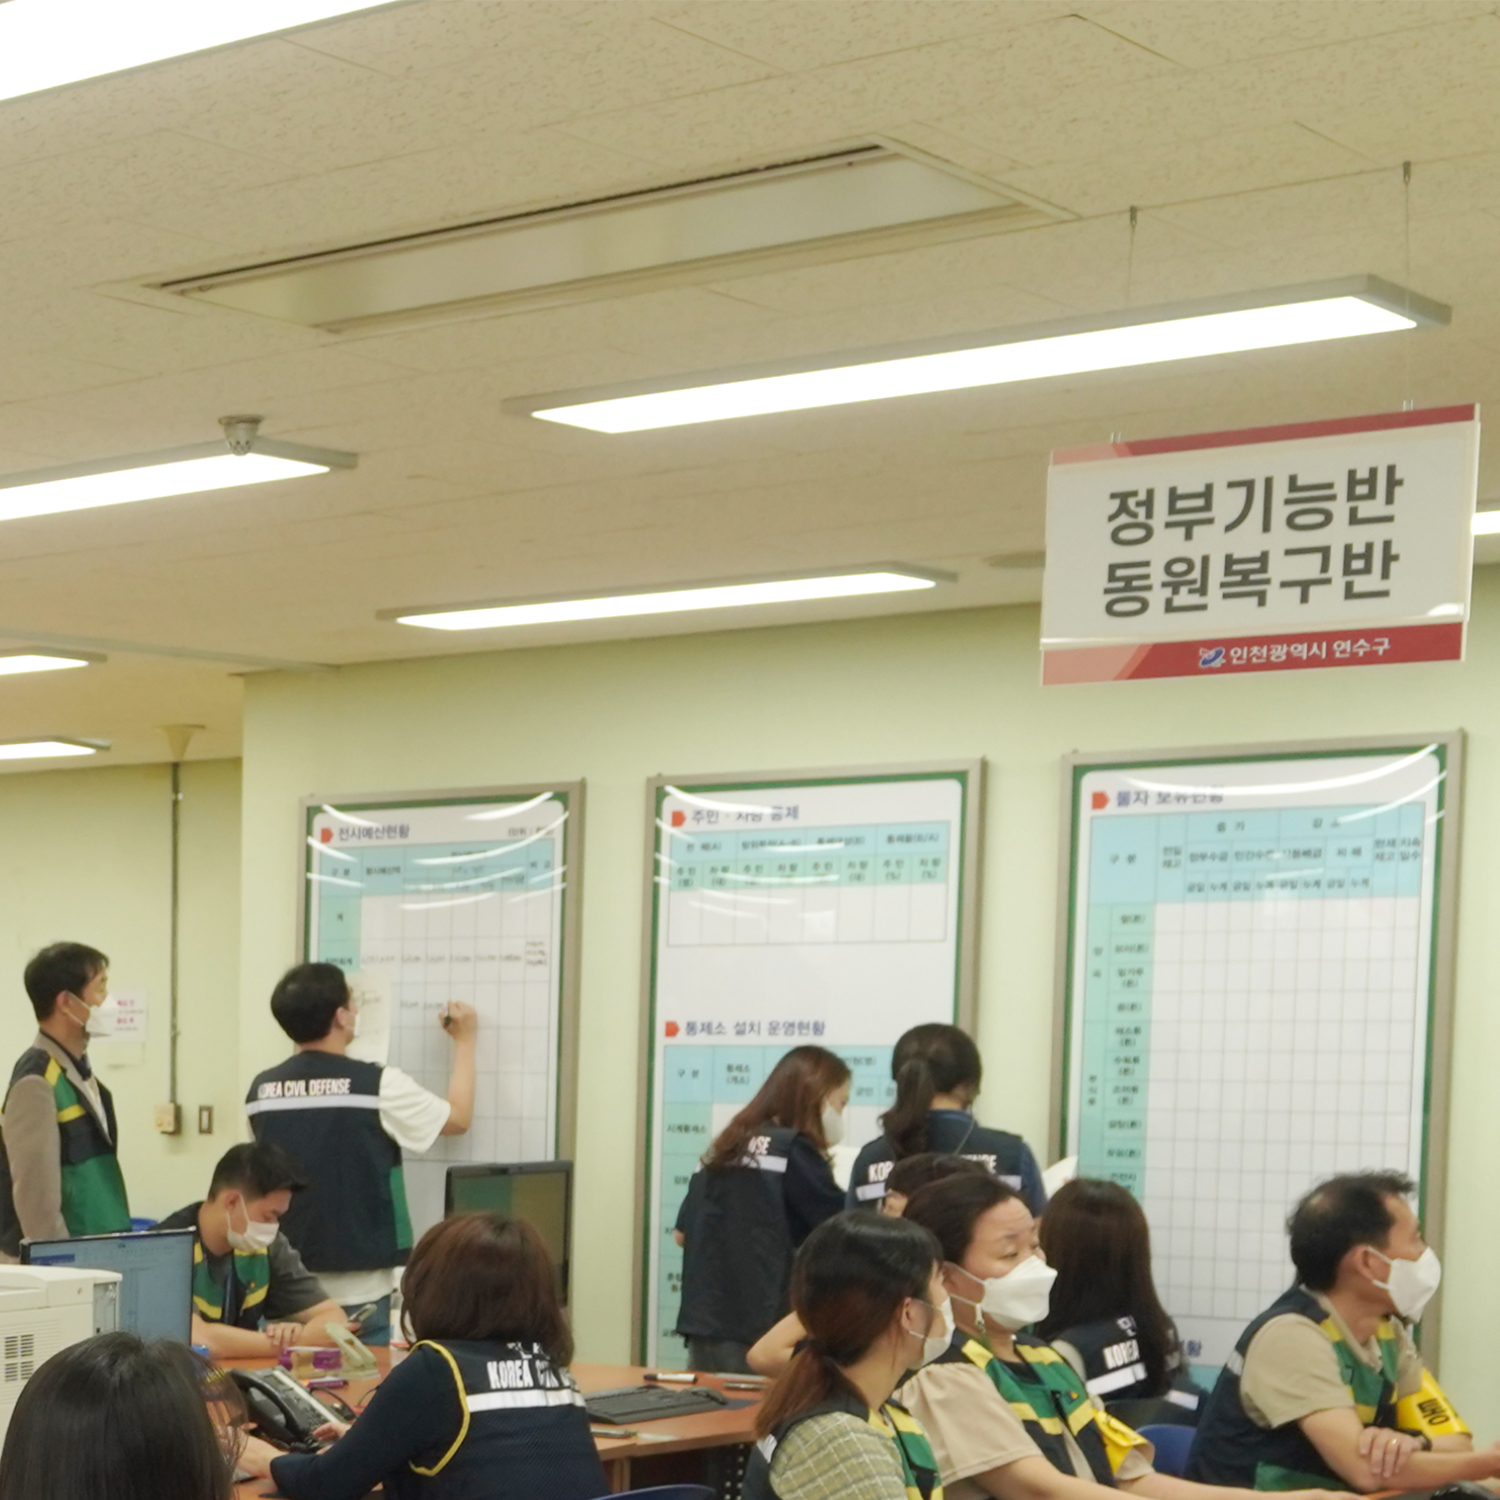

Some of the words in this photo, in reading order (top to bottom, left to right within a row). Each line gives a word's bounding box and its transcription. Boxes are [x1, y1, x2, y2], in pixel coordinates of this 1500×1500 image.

[1107, 464, 1404, 546] 정부기능반
[1103, 539, 1400, 618] 동원복구반
[1229, 642, 1327, 665] 인천광역시
[1333, 637, 1391, 659] 연수구
[338, 824, 410, 842] 전시예산현황
[309, 1078, 351, 1095] DEFENSE
[486, 1359, 534, 1390] KOREA
